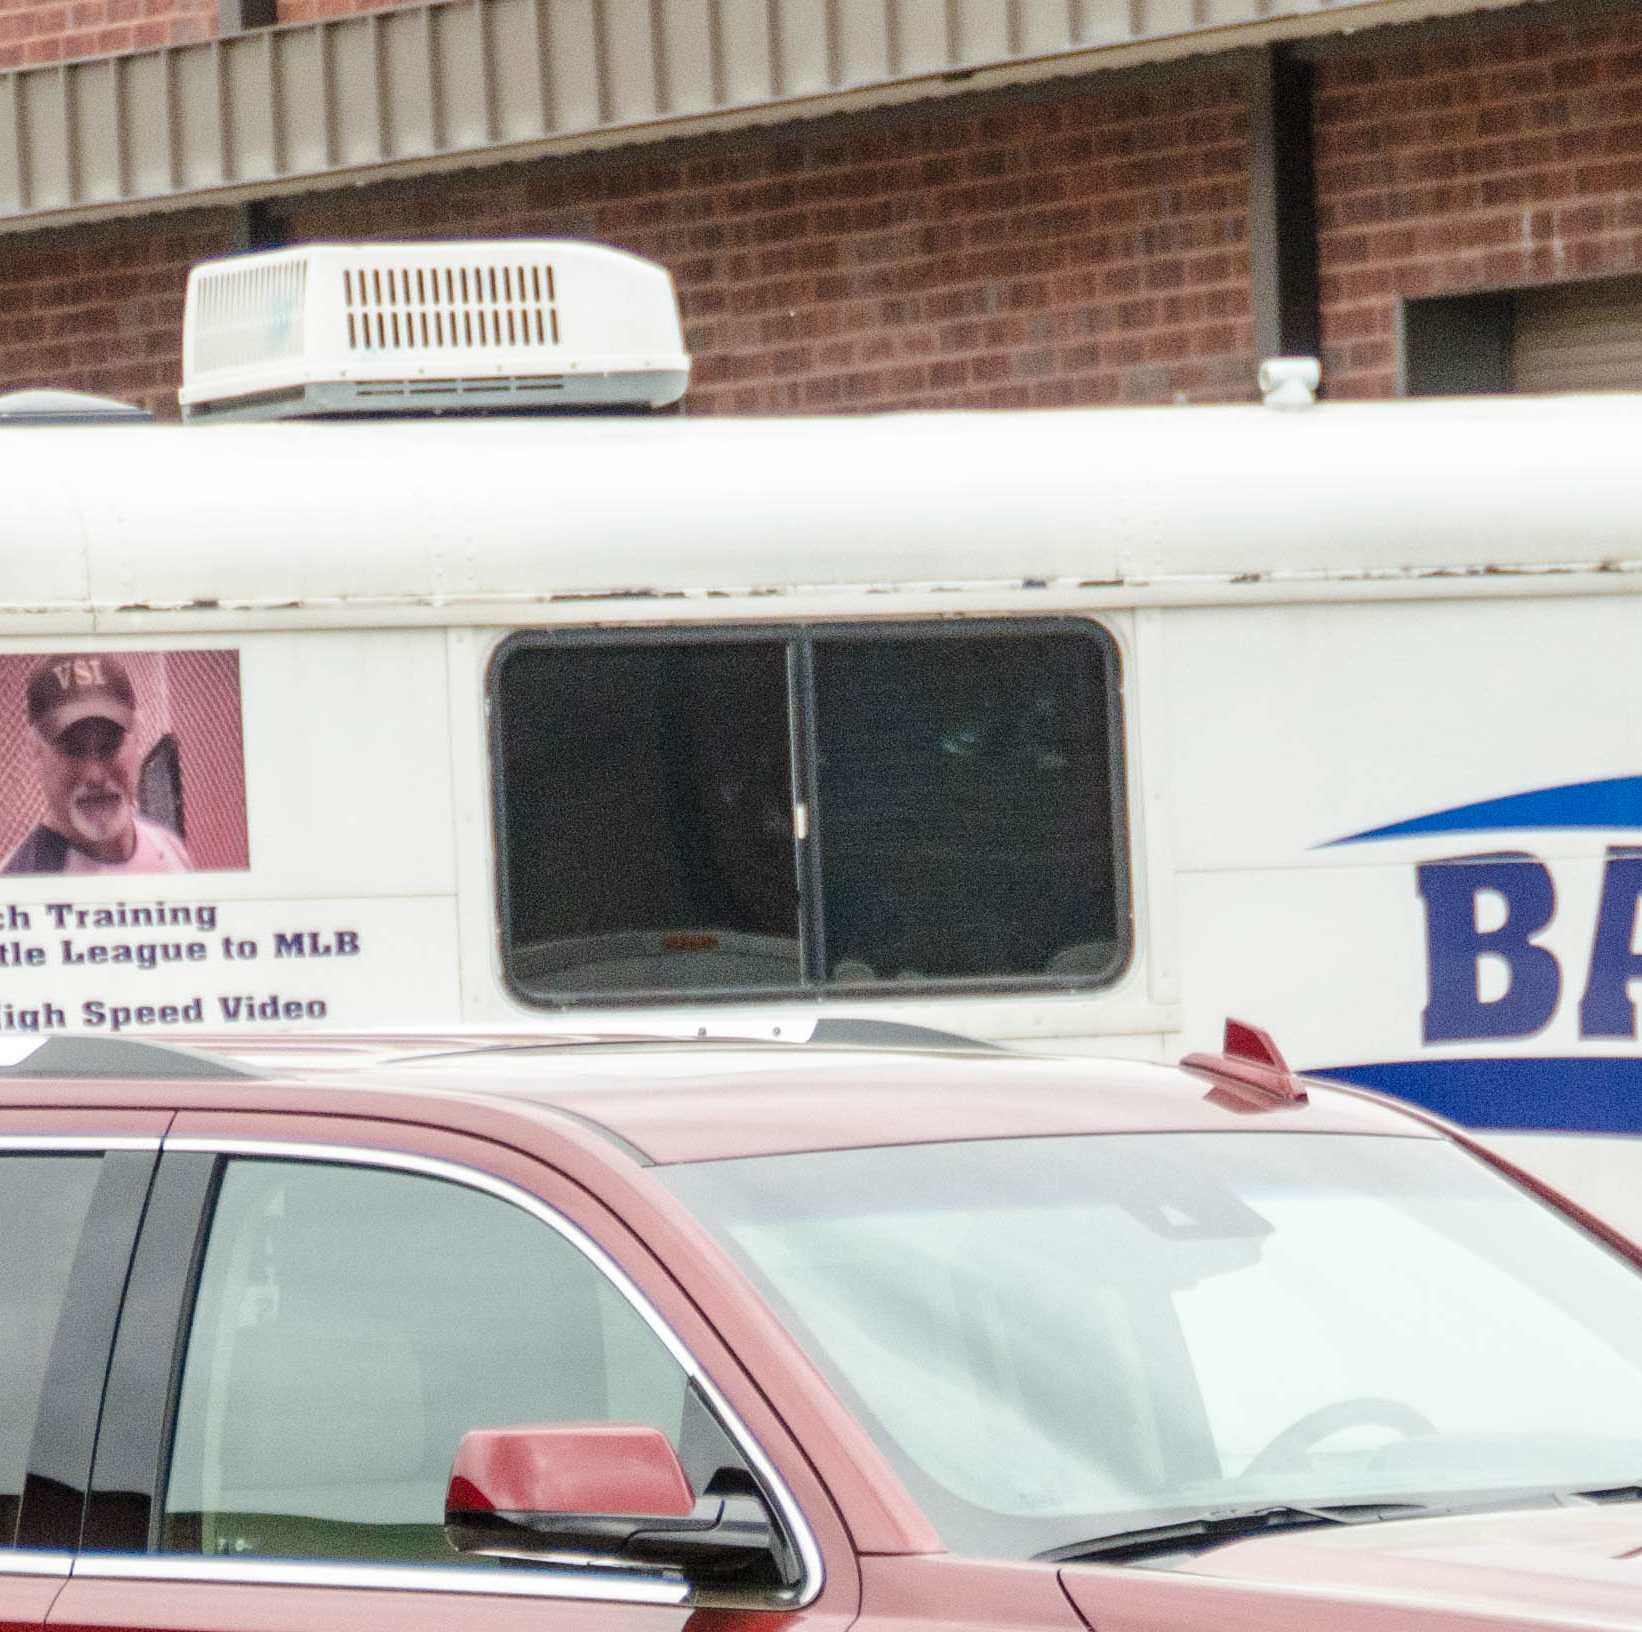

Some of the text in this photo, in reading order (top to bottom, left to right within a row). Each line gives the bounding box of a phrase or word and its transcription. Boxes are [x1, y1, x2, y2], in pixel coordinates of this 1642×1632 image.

[53, 659, 105, 689] VSI
[45, 901, 217, 932] Training
[60, 939, 208, 970] League
[222, 936, 258, 960] to
[273, 931, 361, 959] MLB
[82, 998, 204, 1032] Speed
[218, 995, 328, 1023] Video
